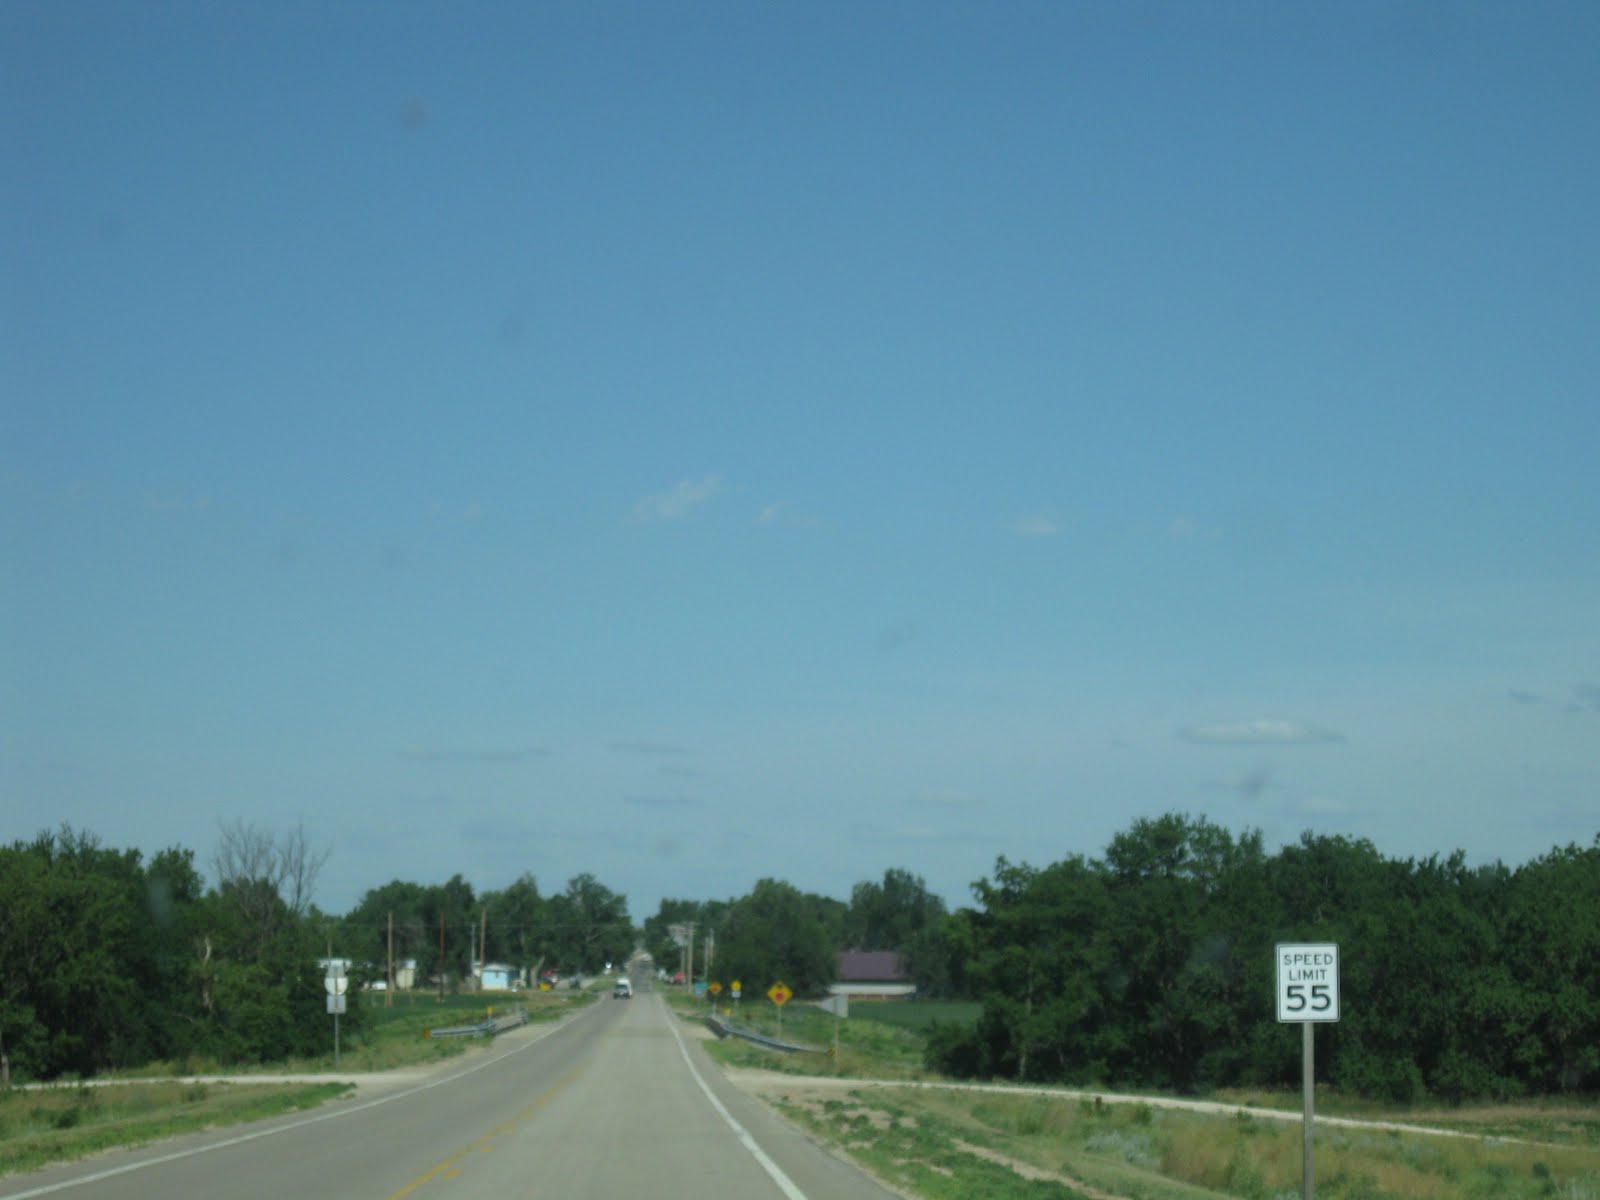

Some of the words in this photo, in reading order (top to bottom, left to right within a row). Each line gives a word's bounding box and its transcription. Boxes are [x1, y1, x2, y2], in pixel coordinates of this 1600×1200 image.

[1284, 953, 1334, 966] SPEED
[1289, 969, 1328, 981] LIMIT
[1286, 985, 1332, 1012] 55
